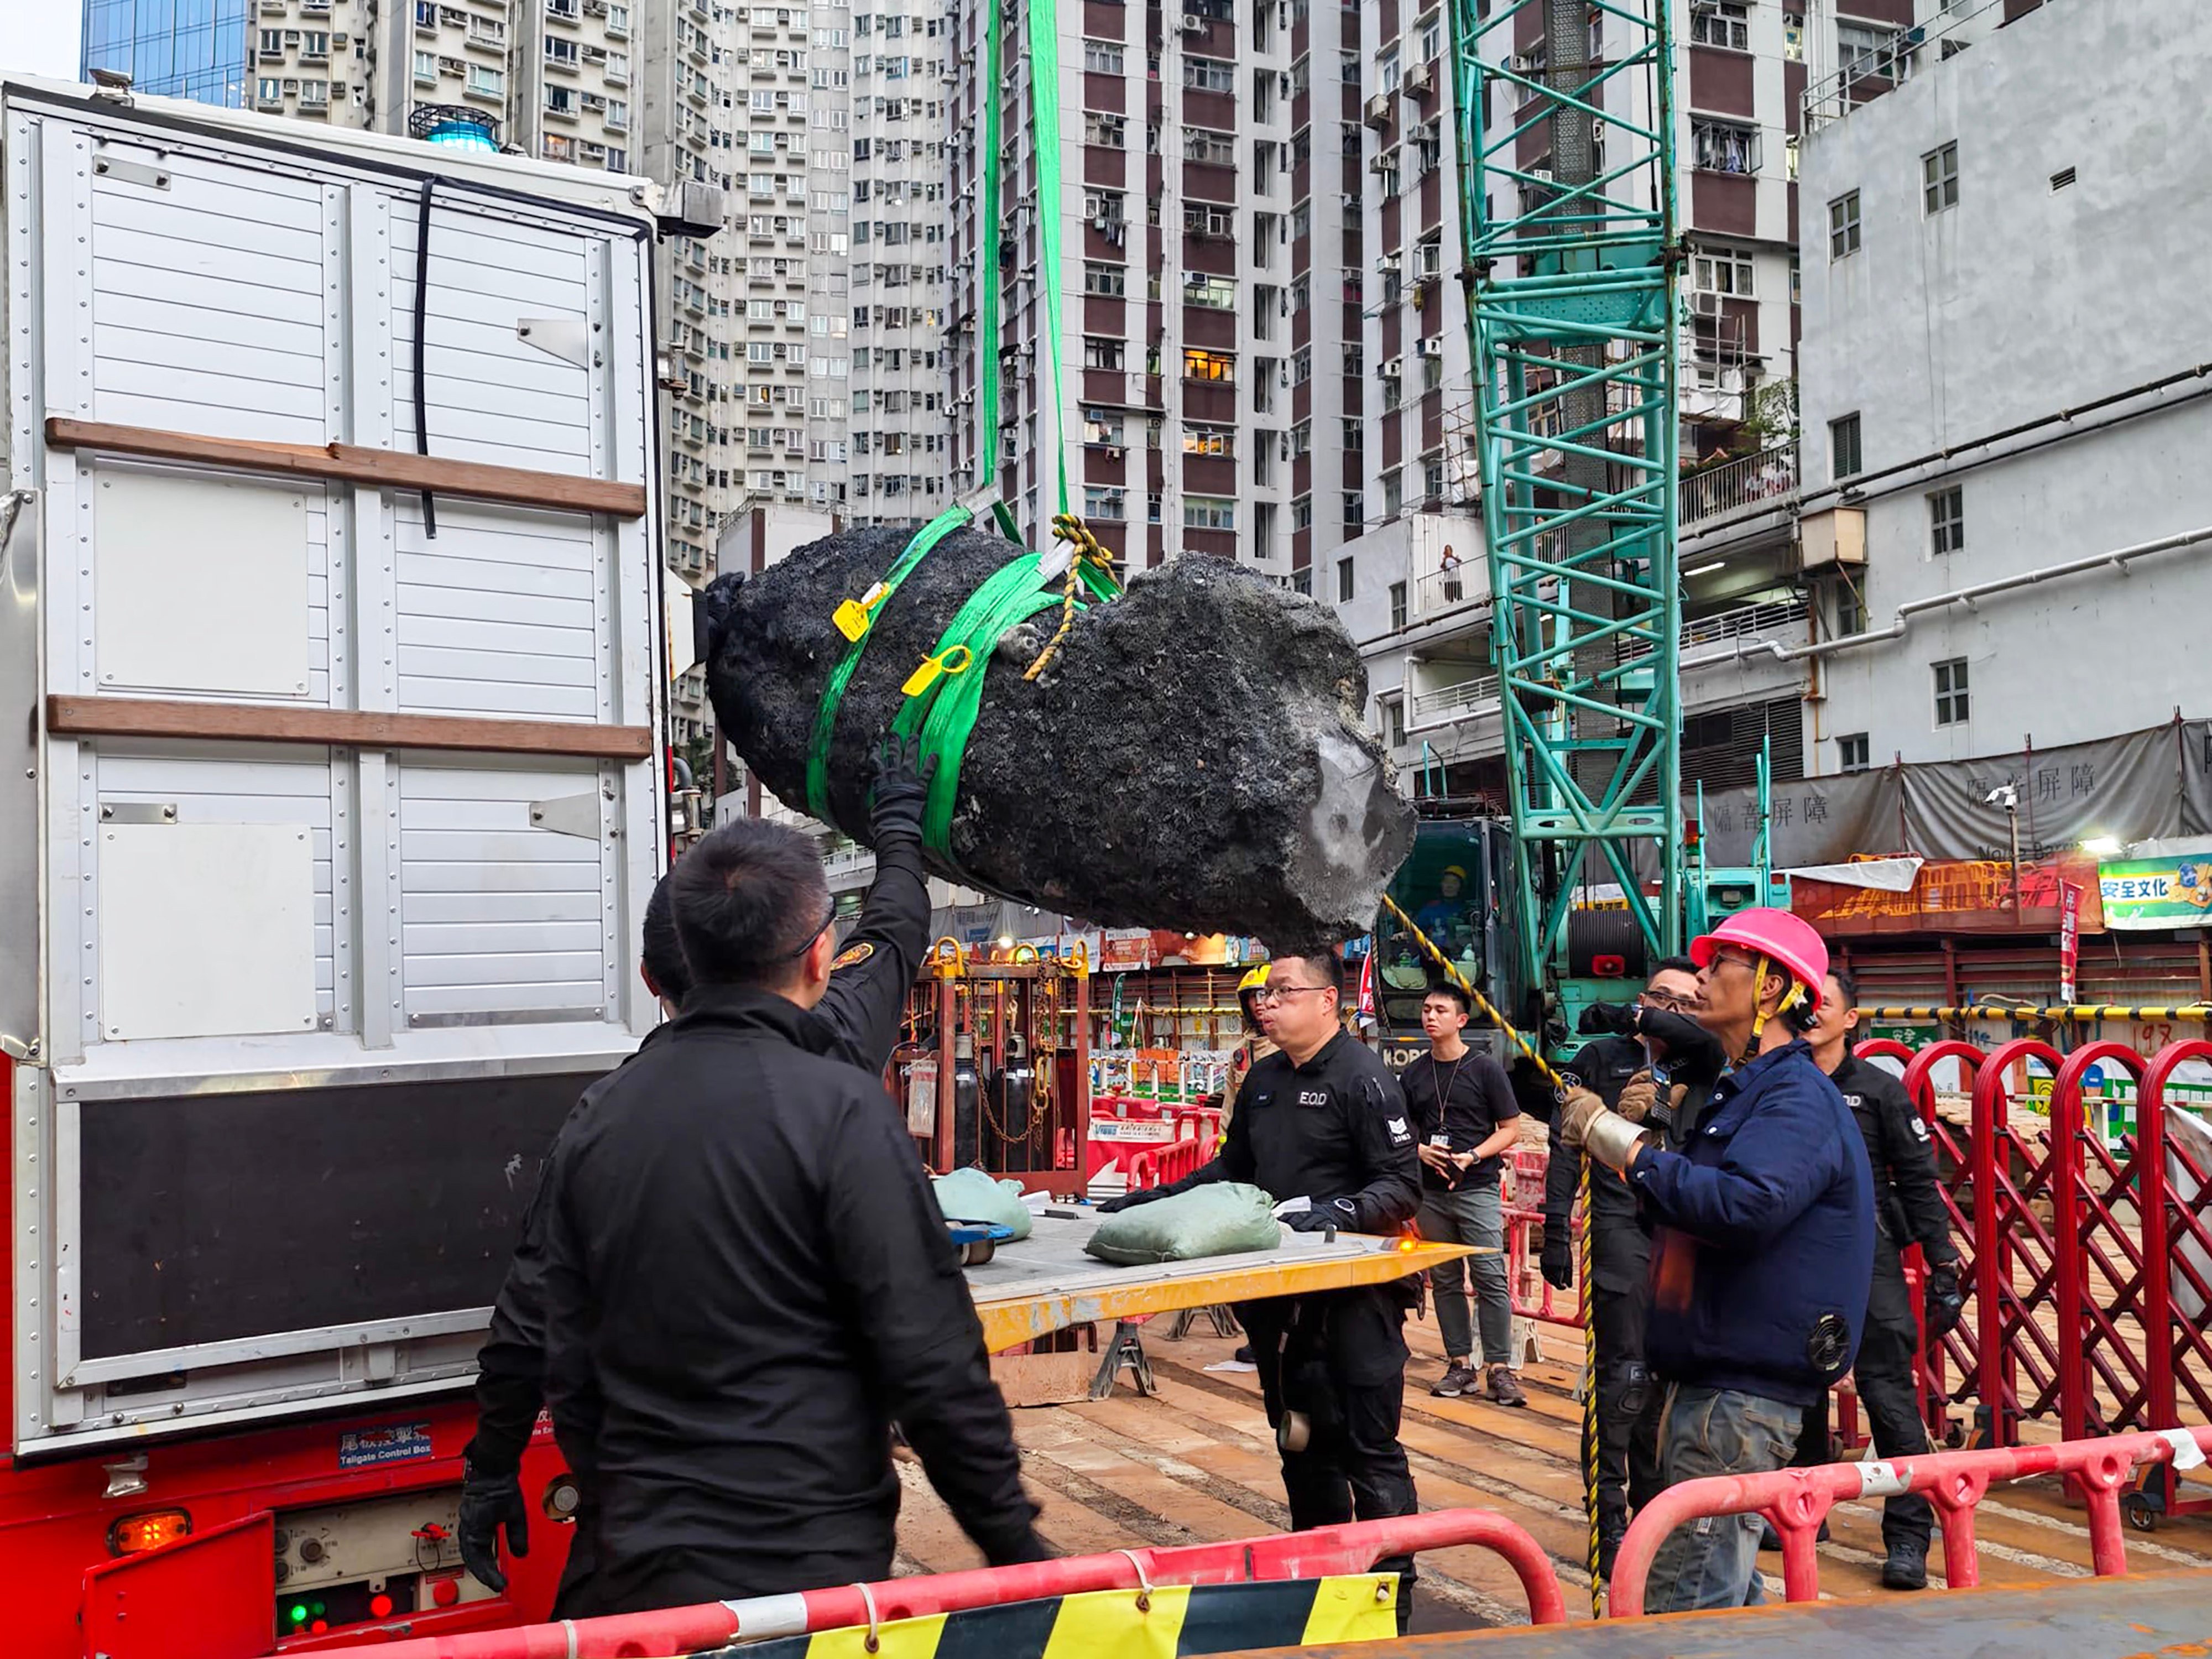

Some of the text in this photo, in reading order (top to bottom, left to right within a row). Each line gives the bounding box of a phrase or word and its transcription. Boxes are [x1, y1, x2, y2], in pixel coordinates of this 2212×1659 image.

[2101, 878, 2168, 899] 安全文化
[1300, 1092, 1327, 1105] EOD
[341, 1445, 431, 1464] Tailgate Control Box
